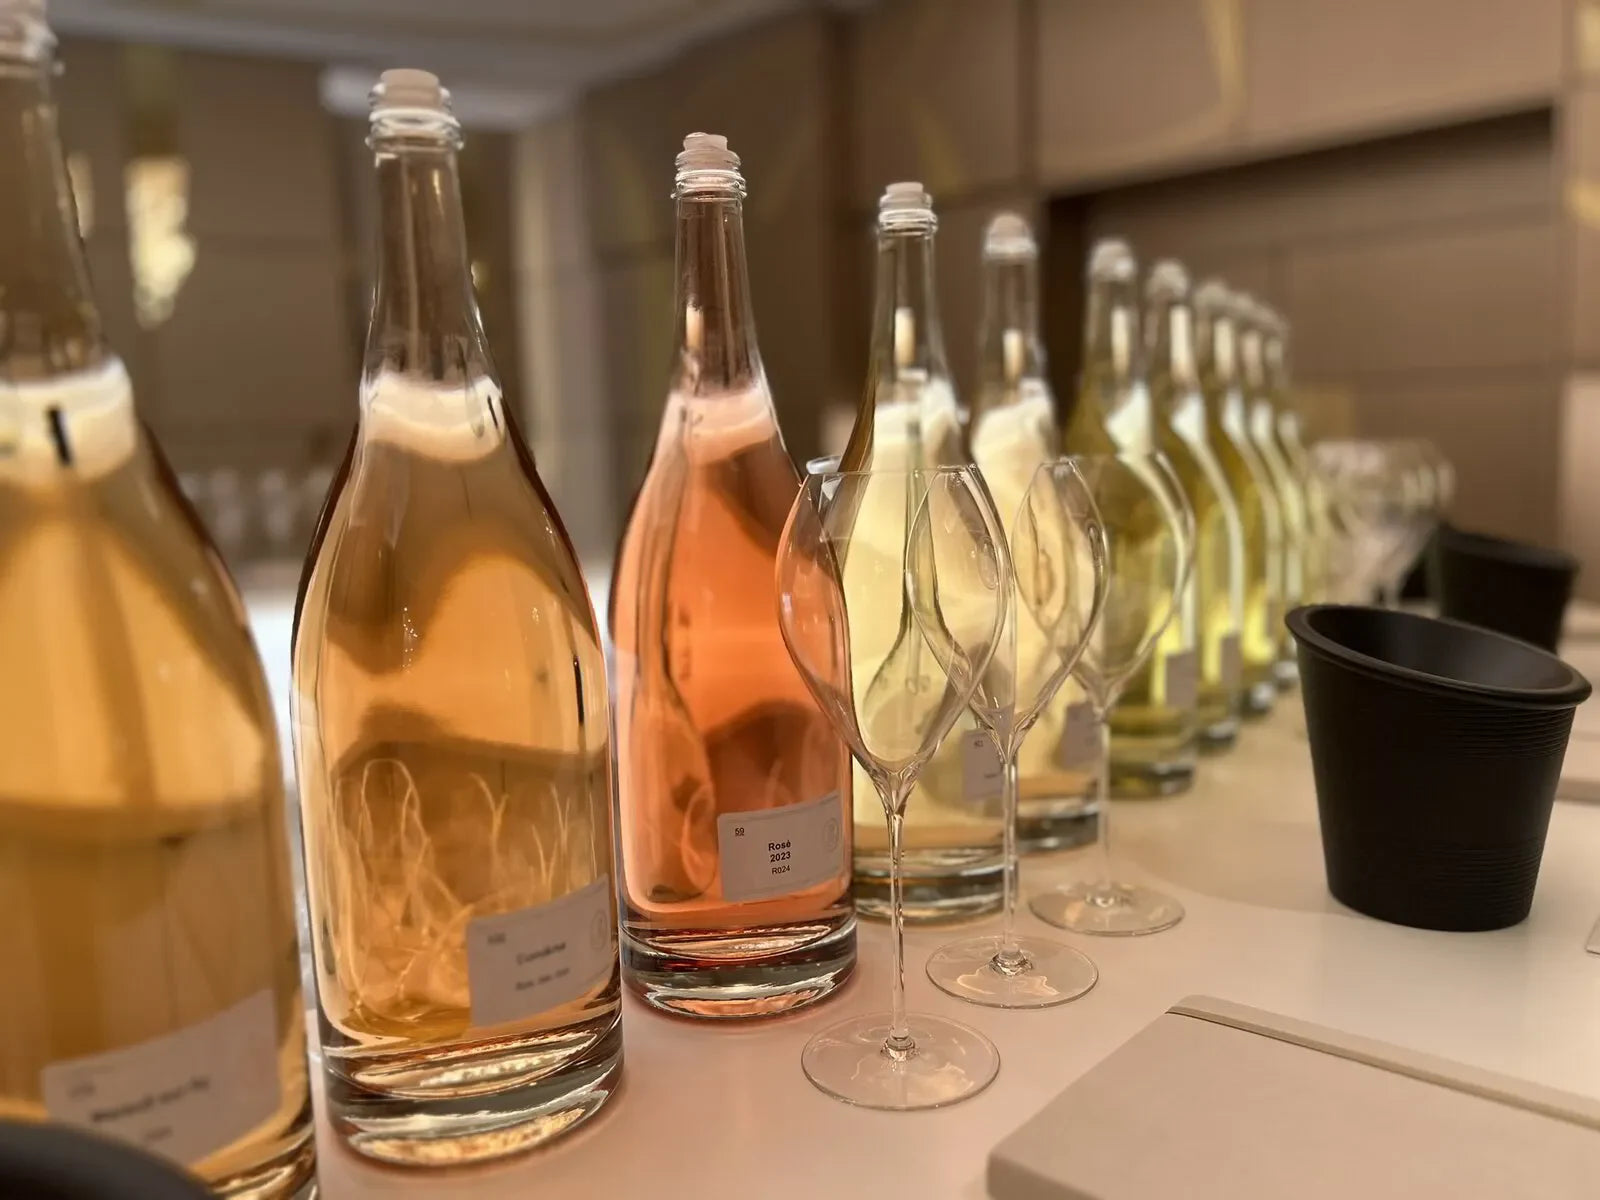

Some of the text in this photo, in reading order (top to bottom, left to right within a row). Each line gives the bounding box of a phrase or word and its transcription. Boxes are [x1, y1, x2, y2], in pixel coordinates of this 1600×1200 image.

[768, 839, 791, 851] Rosé
[770, 851, 791, 862] 2023
[771, 865, 790, 875] R024
